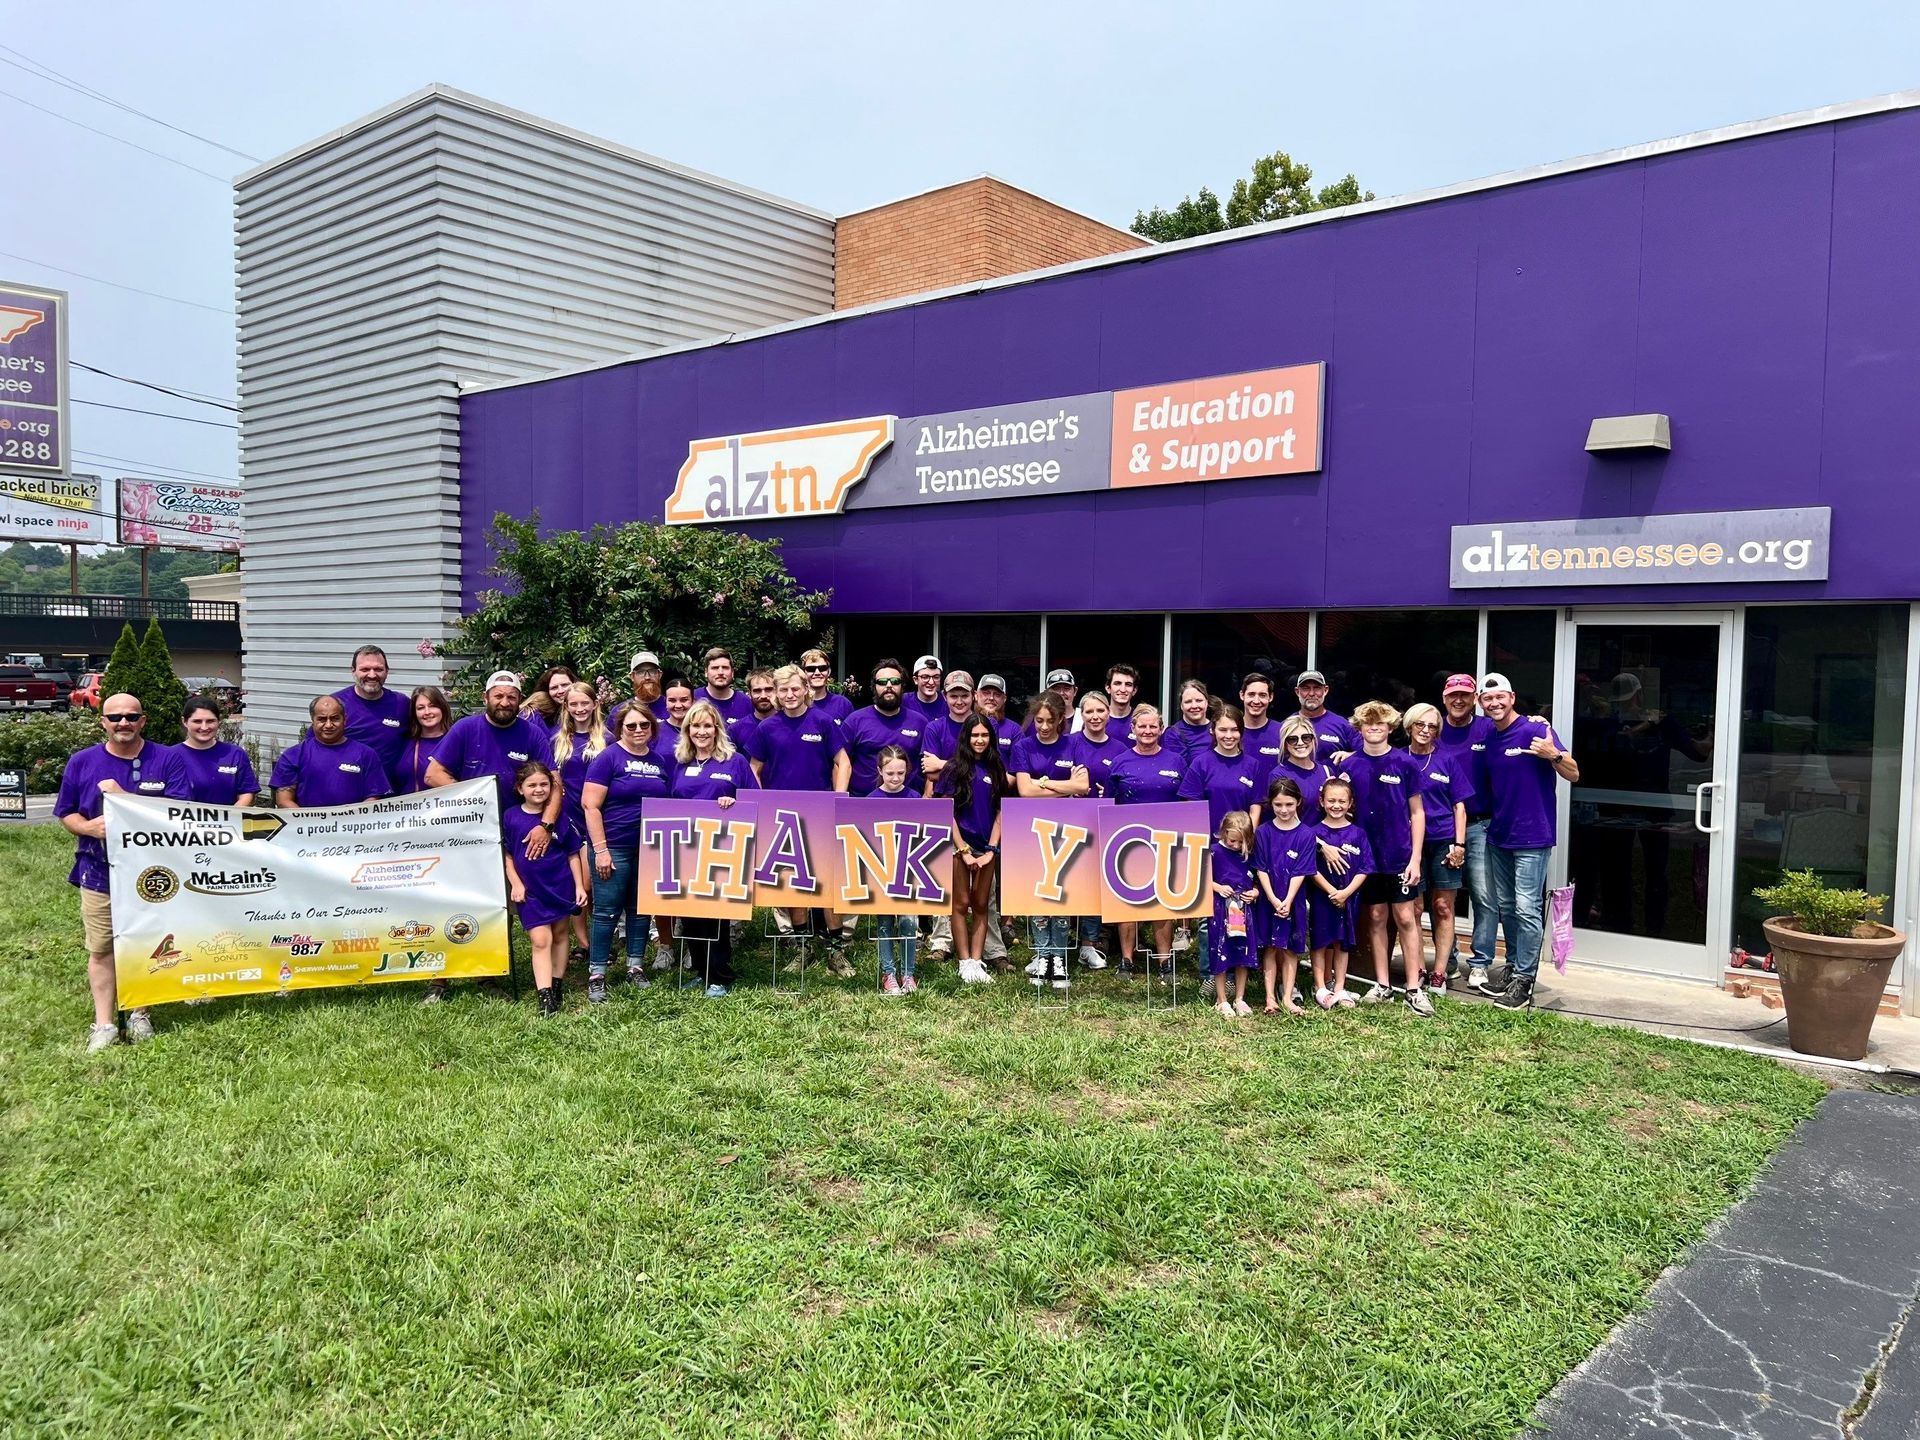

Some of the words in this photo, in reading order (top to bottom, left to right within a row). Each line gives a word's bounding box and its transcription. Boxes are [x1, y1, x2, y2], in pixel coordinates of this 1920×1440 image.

[1132, 385, 1295, 432] Education
[915, 409, 1080, 456] Alzheimer's
[0, 439, 51, 460] 288
[1128, 442, 1152, 473] &
[1161, 427, 1297, 477] Support
[704, 438, 821, 518] alztn
[915, 459, 1061, 495] Tennessee
[0, 478, 46, 493] acked
[51, 481, 98, 498] brick?
[156, 484, 240, 510] Exterior
[50, 496, 61, 505] Fix
[14, 515, 54, 527] space
[57, 517, 89, 531] ninja
[187, 514, 213, 532] 25
[1461, 530, 1813, 573] alztennessee.org
[372, 798, 431, 813] Alzheimer's
[434, 796, 487, 809] Tennessee,
[168, 807, 231, 821] PAINT
[183, 822, 194, 830] IT
[296, 826, 304, 835] a
[307, 820, 338, 837] proud
[342, 820, 391, 834] supporter
[395, 816, 405, 829] of
[409, 815, 426, 828] this
[430, 811, 484, 826] community
[121, 831, 233, 848] FORWARD
[297, 848, 318, 858] Our
[322, 845, 351, 857] 2024
[354, 844, 384, 856] Paint
[387, 842, 399, 852] It
[401, 840, 445, 853] Forward
[447, 838, 488, 847] Winner:
[194, 852, 212, 866] By
[642, 808, 951, 902] THANK
[1031, 817, 1211, 911] YOU
[190, 867, 277, 886] McLain's
[365, 863, 422, 874] Alzheimer's
[361, 873, 413, 883] Tennessee
[245, 910, 286, 922] Thanks
[290, 910, 301, 920] to
[306, 907, 329, 918] Our
[332, 906, 389, 919] Sponsors:
[213, 953, 248, 963] DONUTS
[290, 943, 323, 956] 98.7
[419, 952, 444, 963] 620
